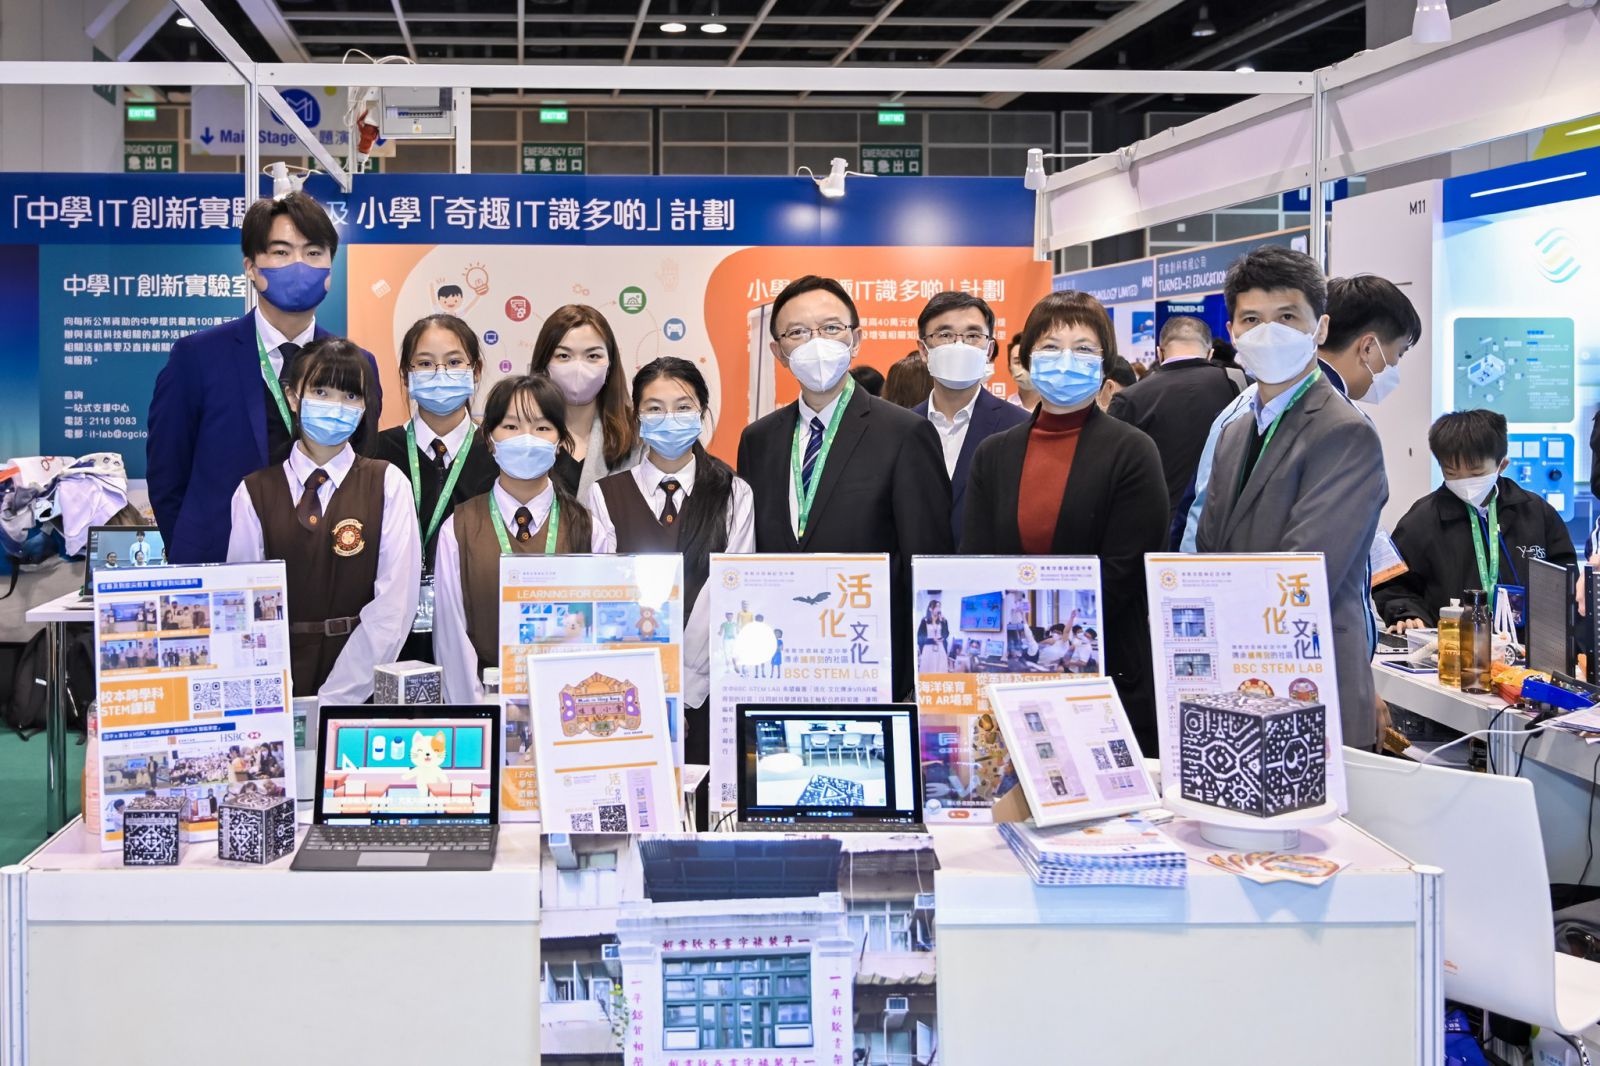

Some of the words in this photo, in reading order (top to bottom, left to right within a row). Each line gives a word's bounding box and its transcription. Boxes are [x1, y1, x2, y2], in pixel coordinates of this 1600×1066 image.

[220, 130, 245, 144] Mai
[259, 130, 296, 146] Stage
[311, 130, 349, 144] 題演
[157, 145, 172, 154] EXIT
[524, 147, 566, 156] EMERGENCY
[568, 147, 583, 156] EXIT
[862, 148, 904, 158] EMERGENCY
[905, 149, 920, 158] EXIT
[524, 157, 583, 172] 緊急出口
[1409, 200, 1426, 215] M11
[356, 196, 735, 231] 小學「奇趣IT識多啲」計劃
[64, 274, 246, 297] 中學IT創新實驗室
[64, 403, 130, 413] 一站式支援中心
[113, 417, 136, 426] 9083
[517, 590, 567, 599] LEARNING
[569, 590, 591, 599] FOR
[593, 589, 623, 598] GOOD
[1233, 664, 1257, 673] BSC
[1262, 664, 1295, 673] STEM
[1300, 663, 1323, 673] LAB
[784, 668, 810, 679] BSC
[814, 668, 849, 679] STEM
[854, 668, 879, 679] LAB
[220, 733, 246, 742] HSBC
